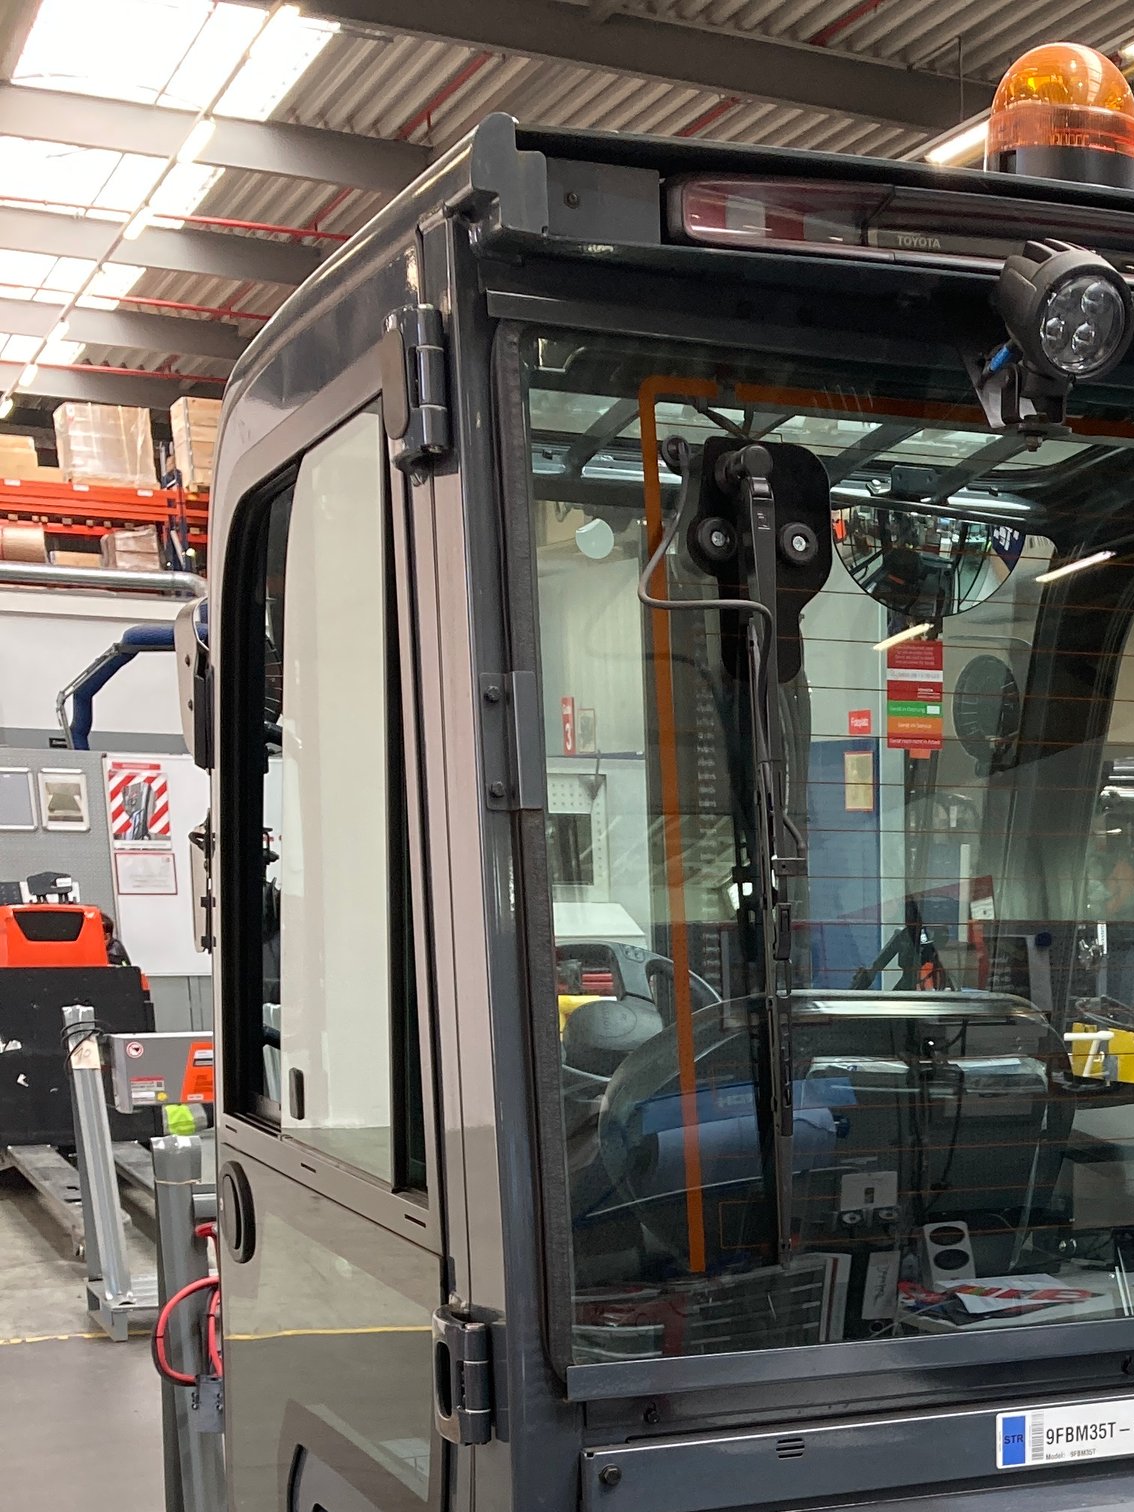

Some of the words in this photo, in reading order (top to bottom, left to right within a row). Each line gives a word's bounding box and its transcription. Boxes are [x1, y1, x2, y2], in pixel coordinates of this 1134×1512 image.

[897, 234, 941, 249] TOYOTA
[565, 723, 572, 751] 3
[1004, 1434, 1025, 1445] STR
